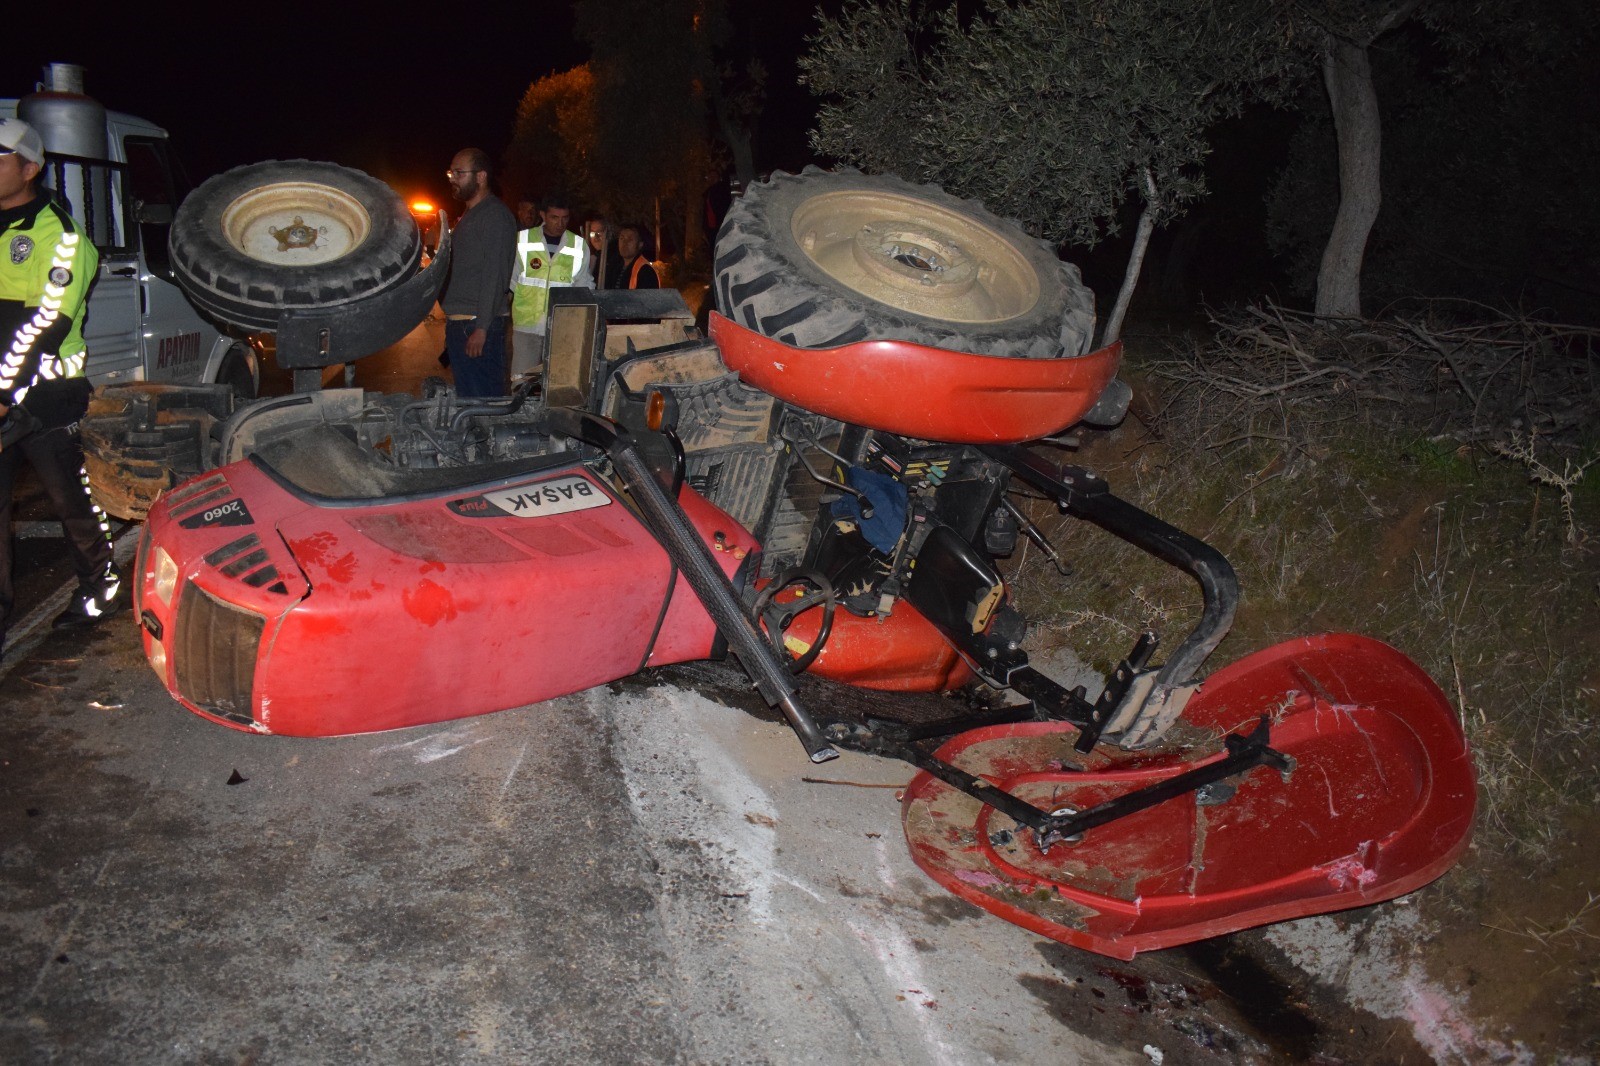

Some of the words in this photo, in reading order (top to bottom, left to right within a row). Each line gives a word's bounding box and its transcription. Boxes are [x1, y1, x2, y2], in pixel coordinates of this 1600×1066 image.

[156, 332, 200, 370] APAYDIN
[458, 500, 488, 512] Plus
[505, 481, 593, 511] BAŞAK
[203, 501, 240, 522] 2060
